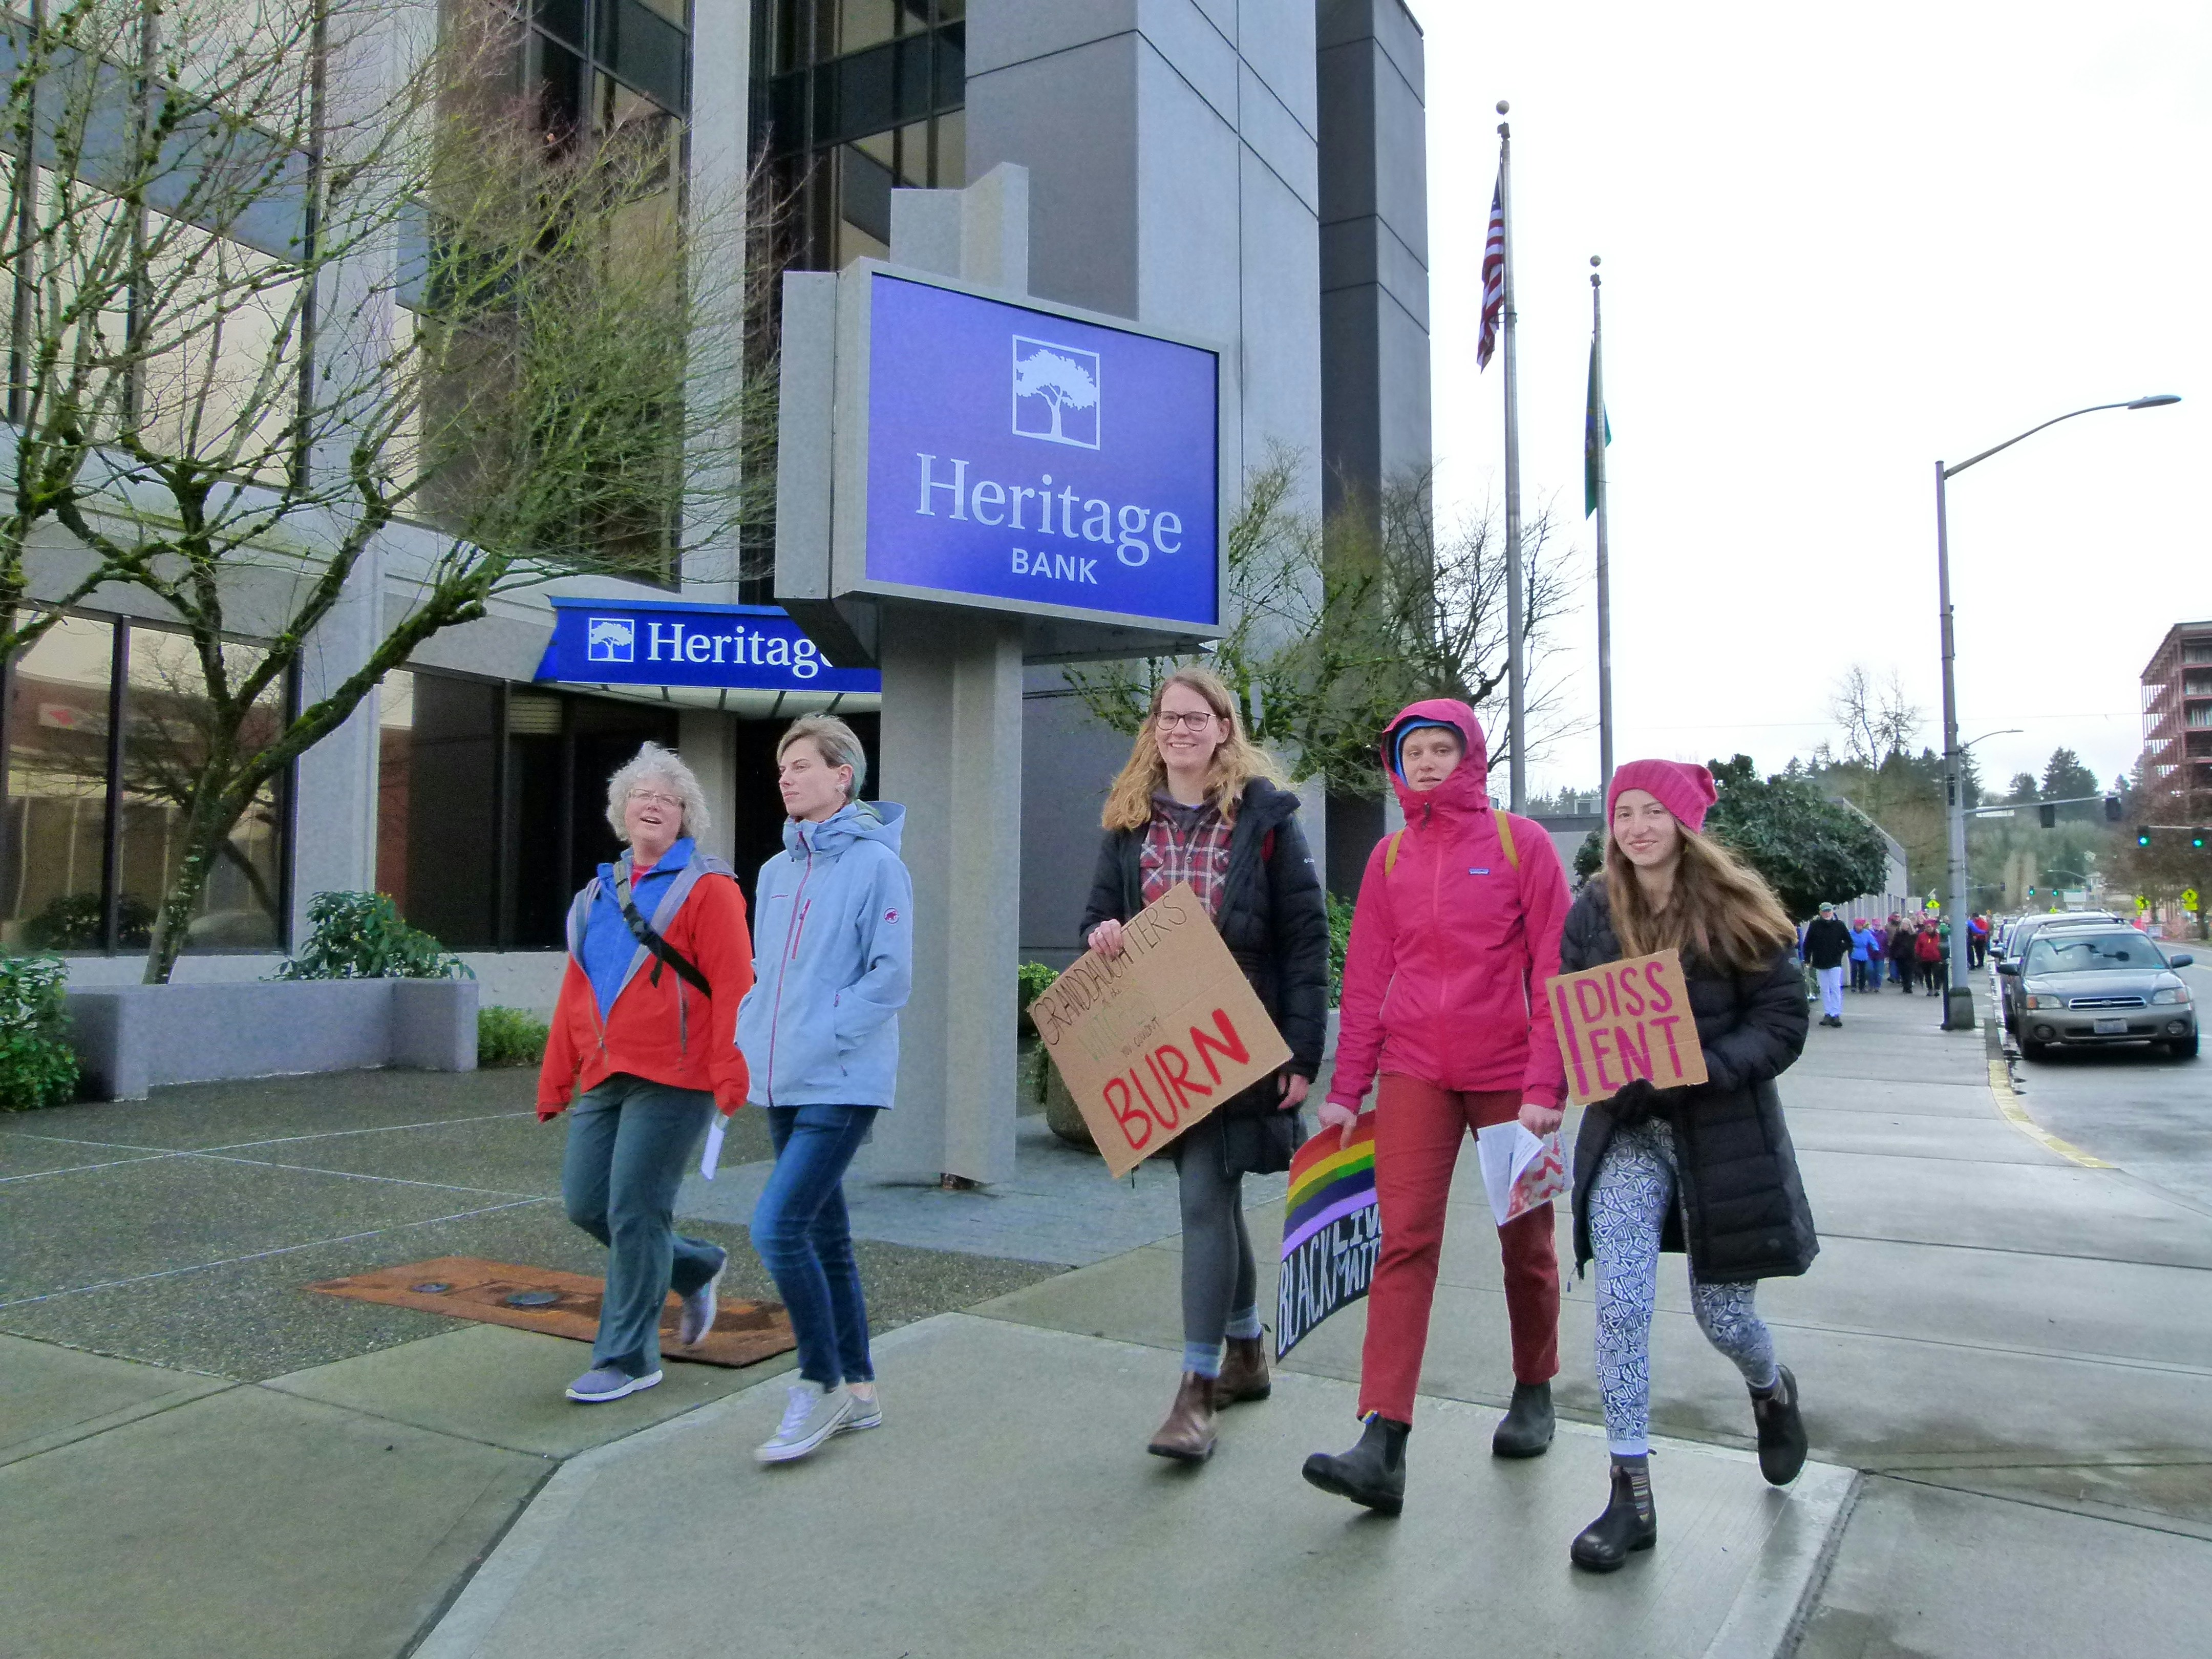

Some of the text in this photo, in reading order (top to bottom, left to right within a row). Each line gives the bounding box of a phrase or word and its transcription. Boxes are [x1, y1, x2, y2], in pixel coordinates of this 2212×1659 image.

[916, 452, 1182, 567] Heritage
[1012, 547, 1098, 585] BANK
[647, 622, 833, 678] Heritag
[1556, 961, 1673, 1096] I DISS
[1589, 1015, 1683, 1091] ENT
[1103, 1009, 1250, 1151] BURN
[1333, 1203, 1382, 1257] LIV
[1279, 1225, 1332, 1355] BLACK
[1332, 1238, 1381, 1306] MATT
